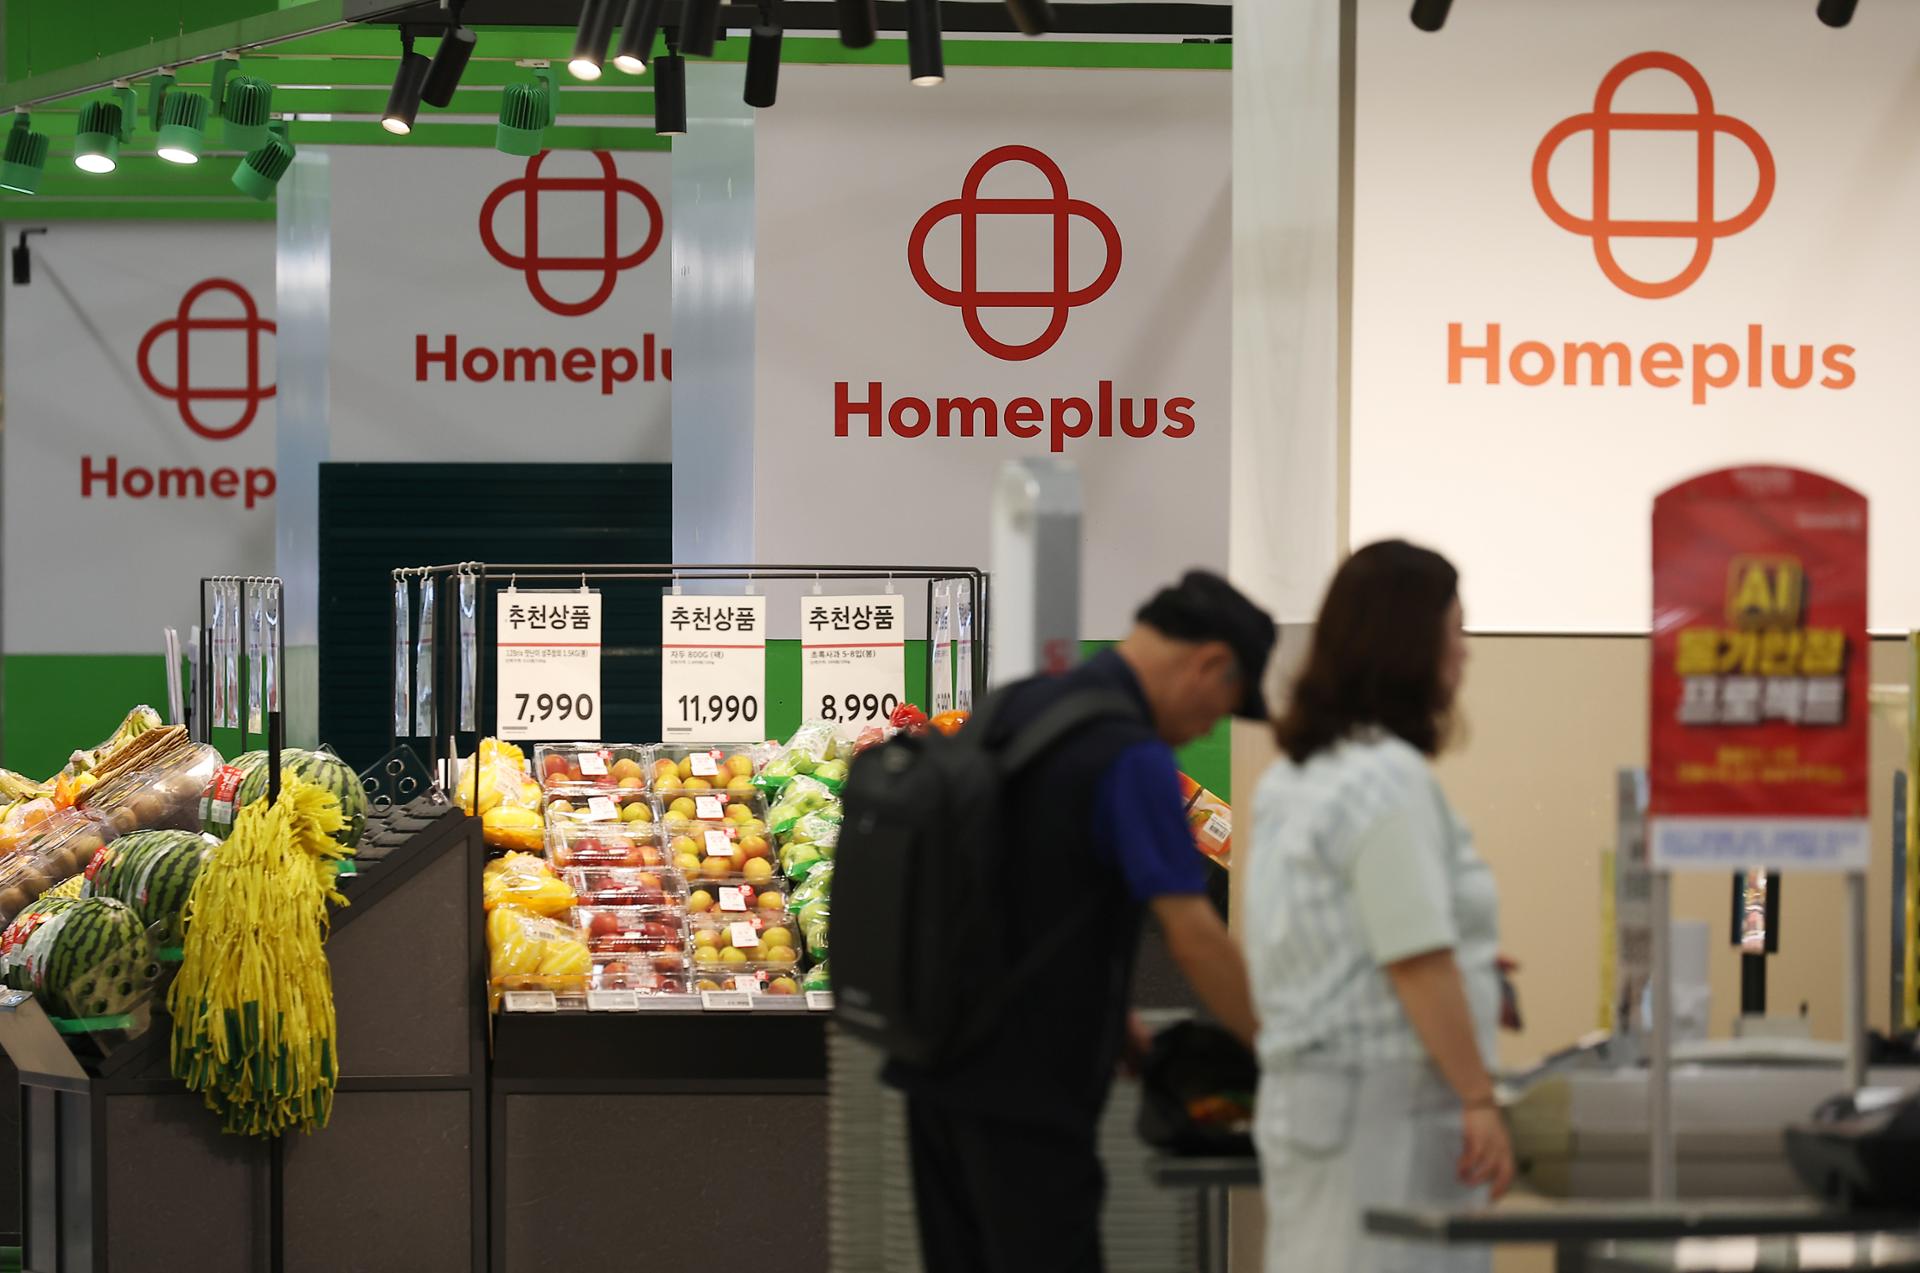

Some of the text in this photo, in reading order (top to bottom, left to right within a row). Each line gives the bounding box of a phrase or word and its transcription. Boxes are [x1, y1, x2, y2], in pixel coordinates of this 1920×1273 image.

[1447, 322, 1857, 406] Homeplus
[834, 380, 1195, 453] Homeplus
[81, 457, 276, 509] Homep
[1735, 566, 1792, 613] AI
[506, 604, 591, 630] 추천상품
[670, 606, 756, 632] 추천상품
[808, 604, 895, 632] 추천상품
[515, 693, 593, 723] 7,990
[678, 694, 758, 725] 11,990
[821, 693, 898, 724] 8,990
